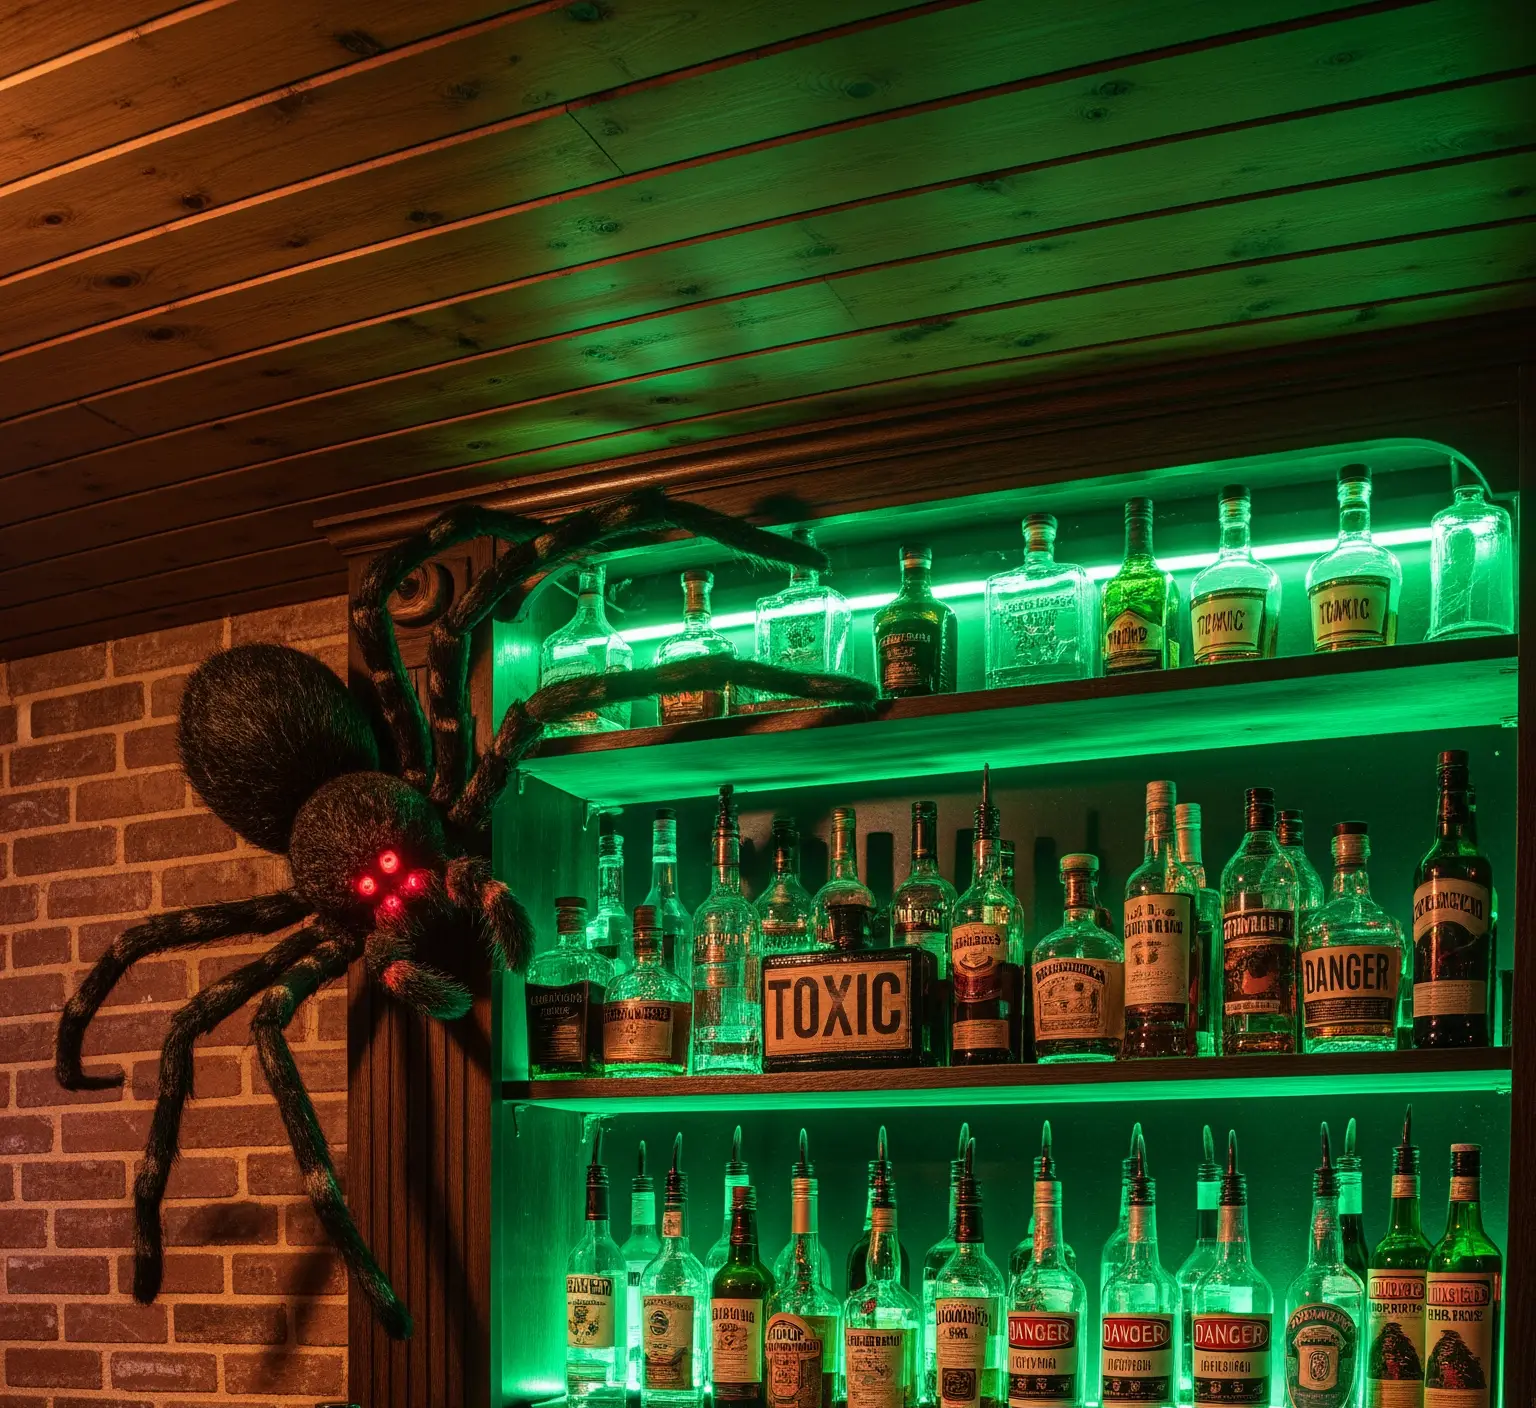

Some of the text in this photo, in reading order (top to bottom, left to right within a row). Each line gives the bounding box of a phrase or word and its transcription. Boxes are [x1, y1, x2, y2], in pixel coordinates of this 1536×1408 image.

[1305, 952, 1390, 994] DANGER
[768, 972, 901, 1040] TOXIC
[1009, 1321, 1070, 1341] DANGER
[1195, 1324, 1263, 1344] DANGER
